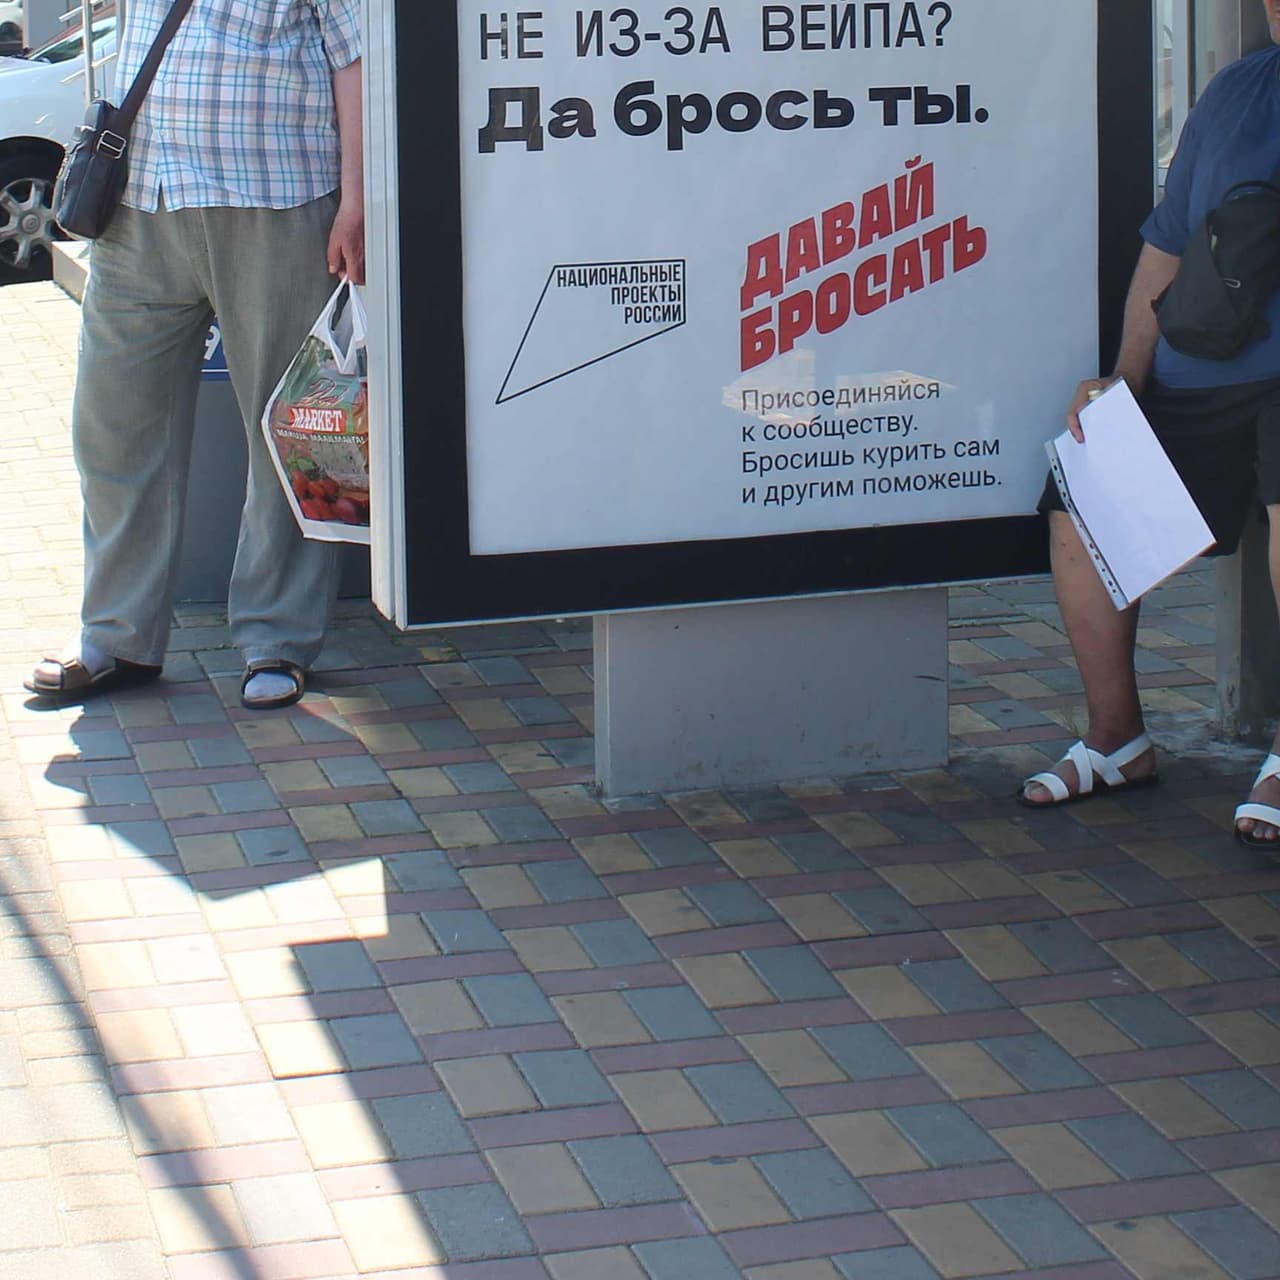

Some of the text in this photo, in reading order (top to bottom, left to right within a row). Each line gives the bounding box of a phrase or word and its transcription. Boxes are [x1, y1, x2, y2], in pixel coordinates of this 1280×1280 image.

[480, 11, 545, 60] НЕ
[576, 6, 731, 58] ИЗ-ЗА
[478, 80, 990, 154] Да брось ты.
[740, 154, 934, 313] ДАВАЙ
[557, 264, 681, 288] НАЦИОНАЛЬНЫЕ
[611, 284, 681, 305] ПРОЕКТЫ
[740, 214, 987, 373] БРОСАТЬ
[624, 304, 682, 324] РОССИИ
[742, 379, 940, 416] Присоединяйся
[290, 407, 343, 432] MARKET
[742, 414, 918, 442] к сообществу.
[742, 439, 1000, 477] Бросишь курить сам
[742, 470, 1002, 507] и другим поможешь.
